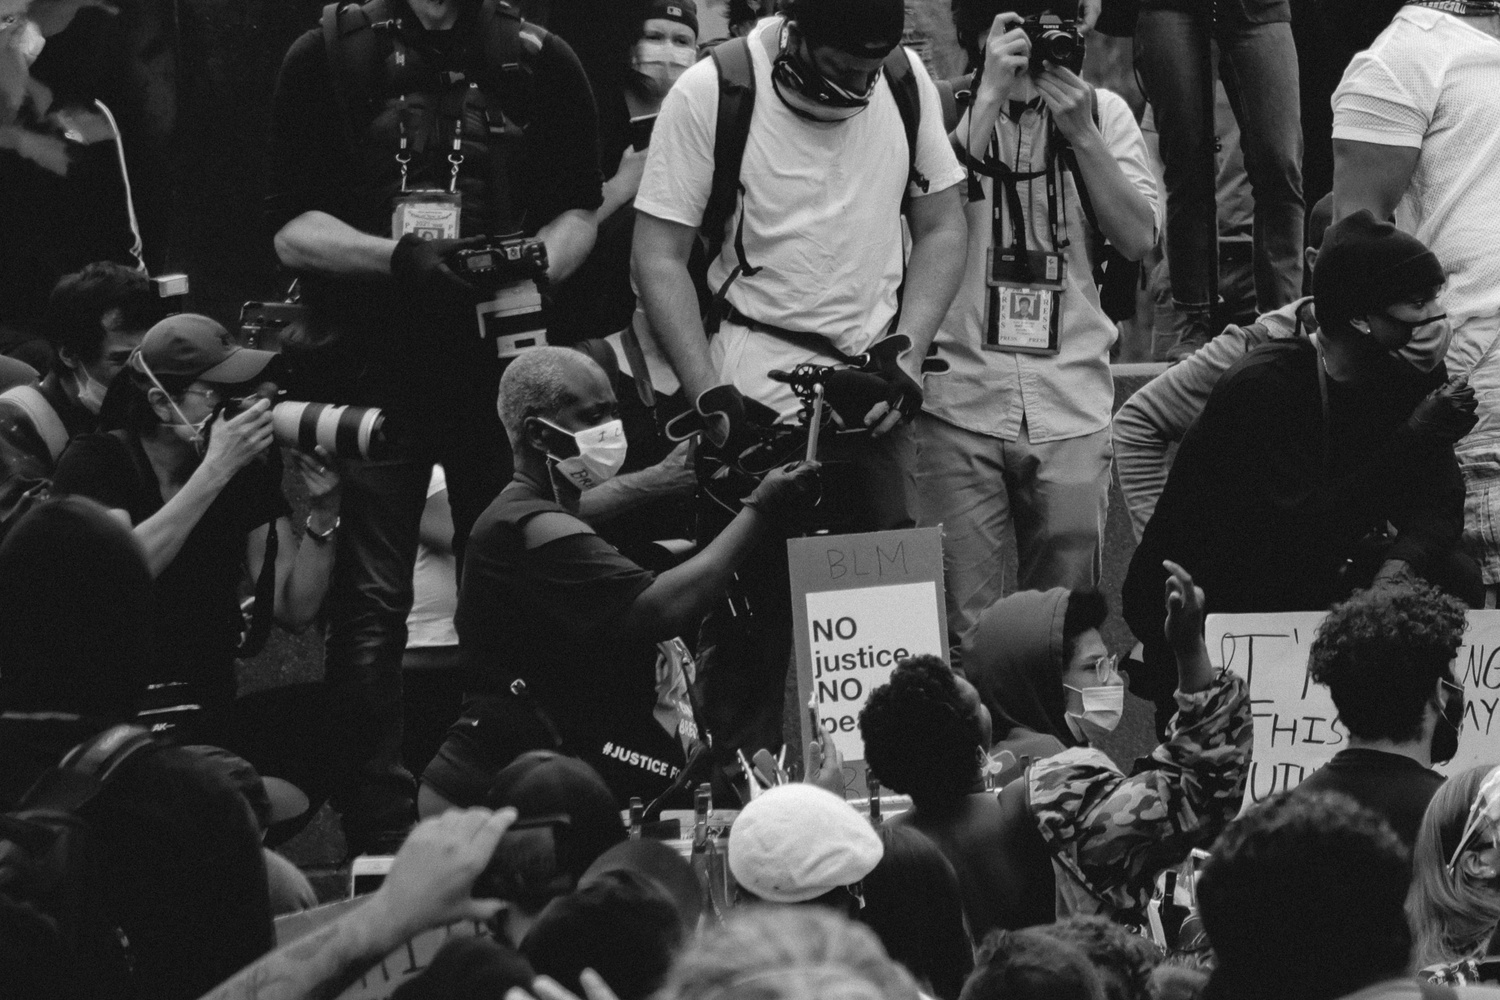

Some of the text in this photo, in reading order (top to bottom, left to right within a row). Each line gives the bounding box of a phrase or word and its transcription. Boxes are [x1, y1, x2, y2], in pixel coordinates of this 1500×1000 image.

[827, 540, 908, 579] BLM
[813, 616, 857, 643] NO
[815, 645, 910, 679] justice
[818, 677, 863, 704] NO
[602, 741, 669, 776] #JUSTICE
